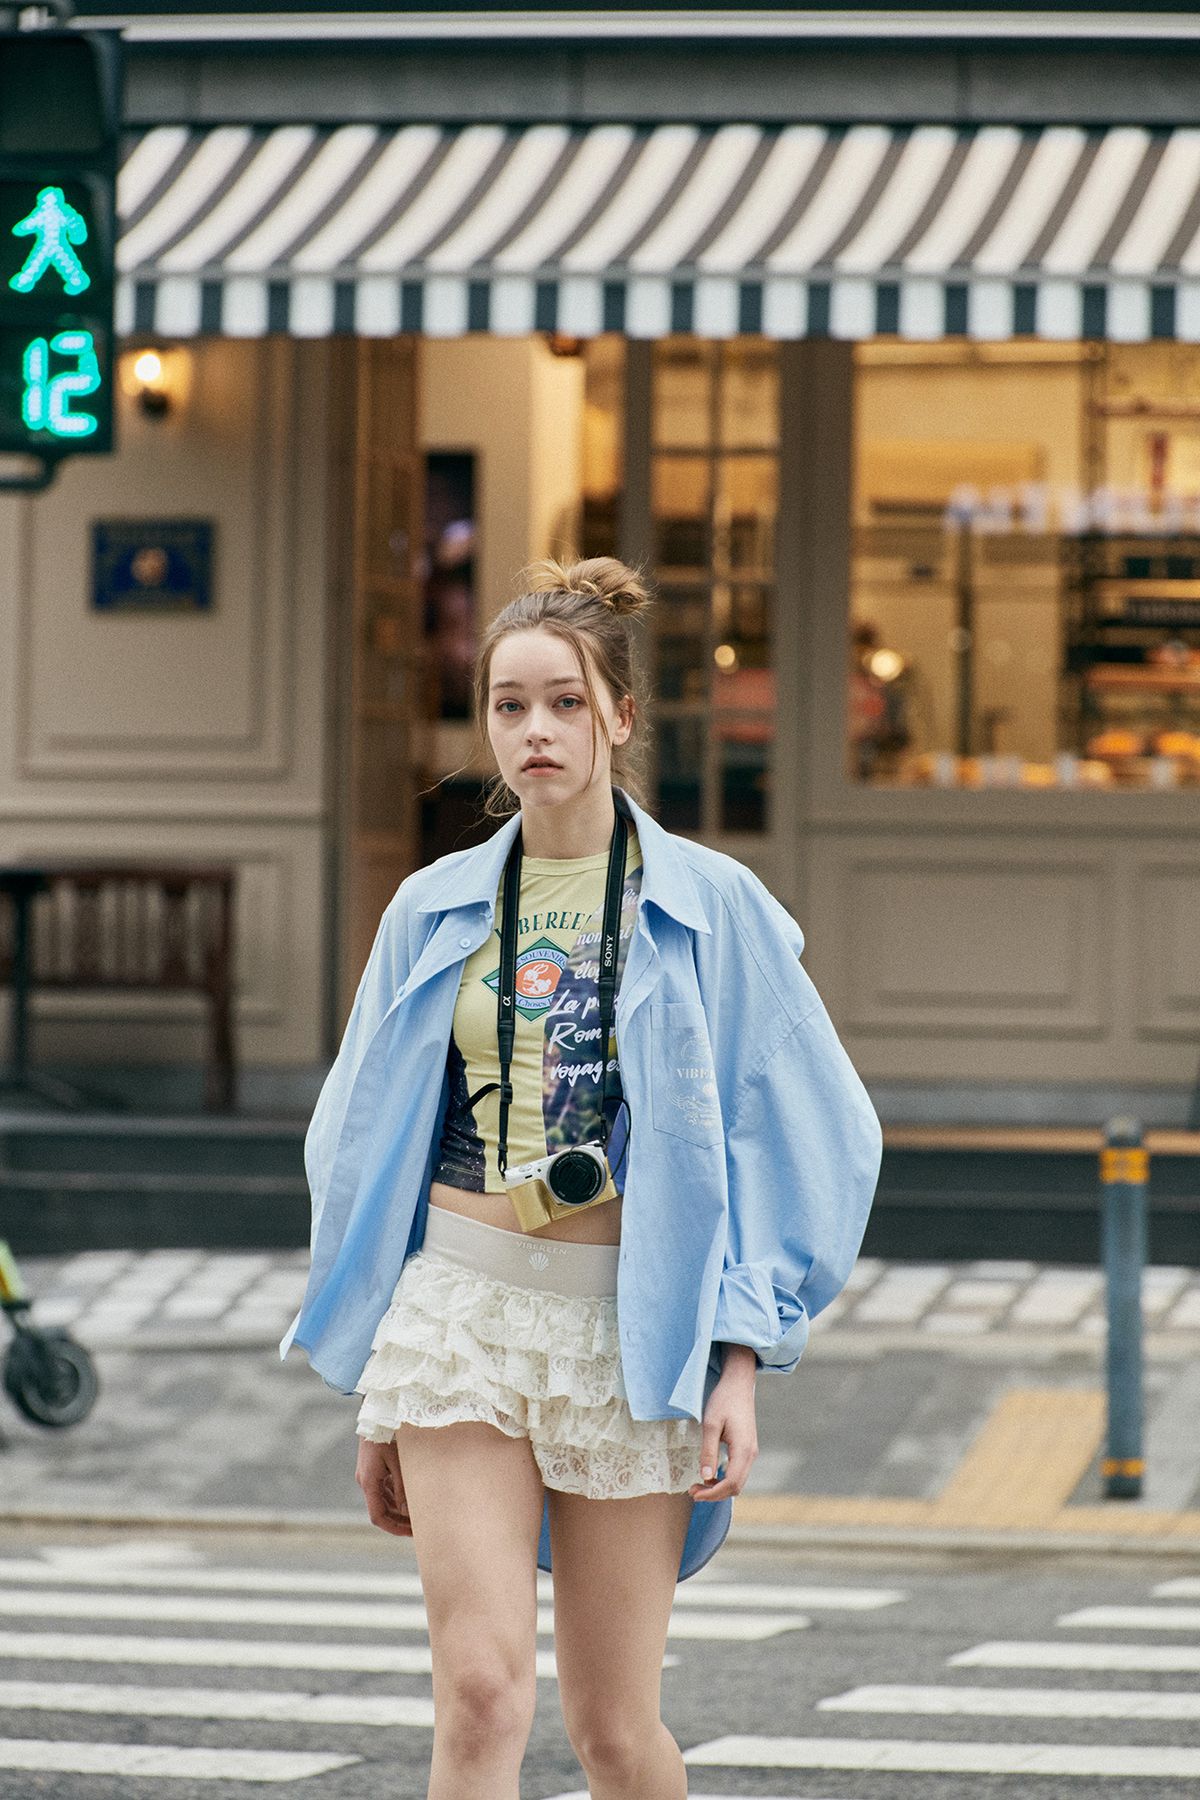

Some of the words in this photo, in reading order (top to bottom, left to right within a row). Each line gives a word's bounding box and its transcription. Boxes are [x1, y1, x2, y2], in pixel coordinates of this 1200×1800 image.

[22, 330, 101, 437] 12
[495, 911, 592, 940] BEREE
[604, 935, 614, 967] SONY
[544, 989, 581, 1018] La
